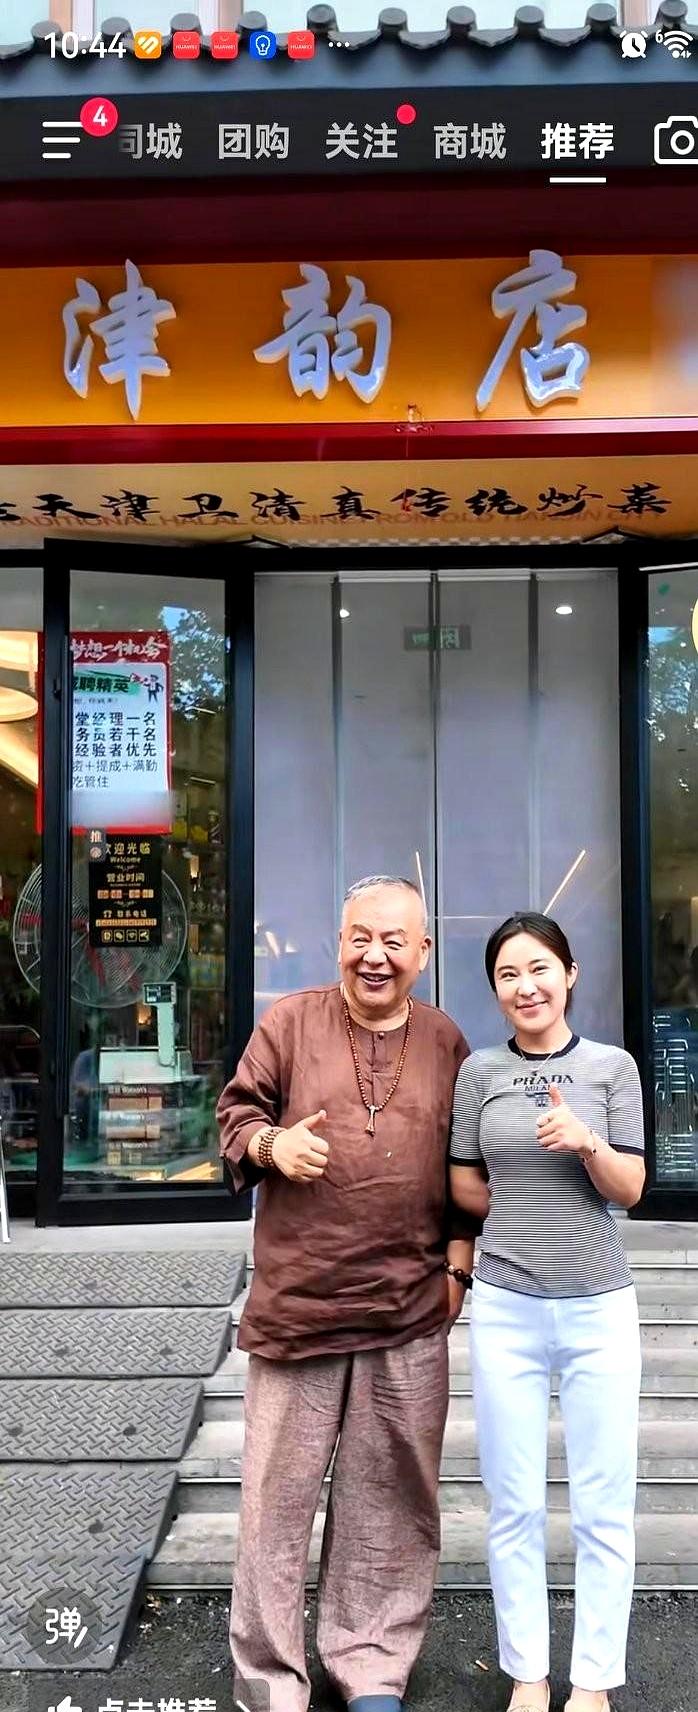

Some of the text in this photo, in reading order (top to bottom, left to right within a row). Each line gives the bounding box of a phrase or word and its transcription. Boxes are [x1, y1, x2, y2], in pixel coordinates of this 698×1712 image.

[62, 249, 591, 422] 津韵店
[75, 711, 156, 727] 堂经理一名
[75, 727, 156, 742] 务员若干名
[74, 742, 157, 757] 经验者优先
[90, 830, 103, 843] 推
[513, 1074, 574, 1086] PRADA
